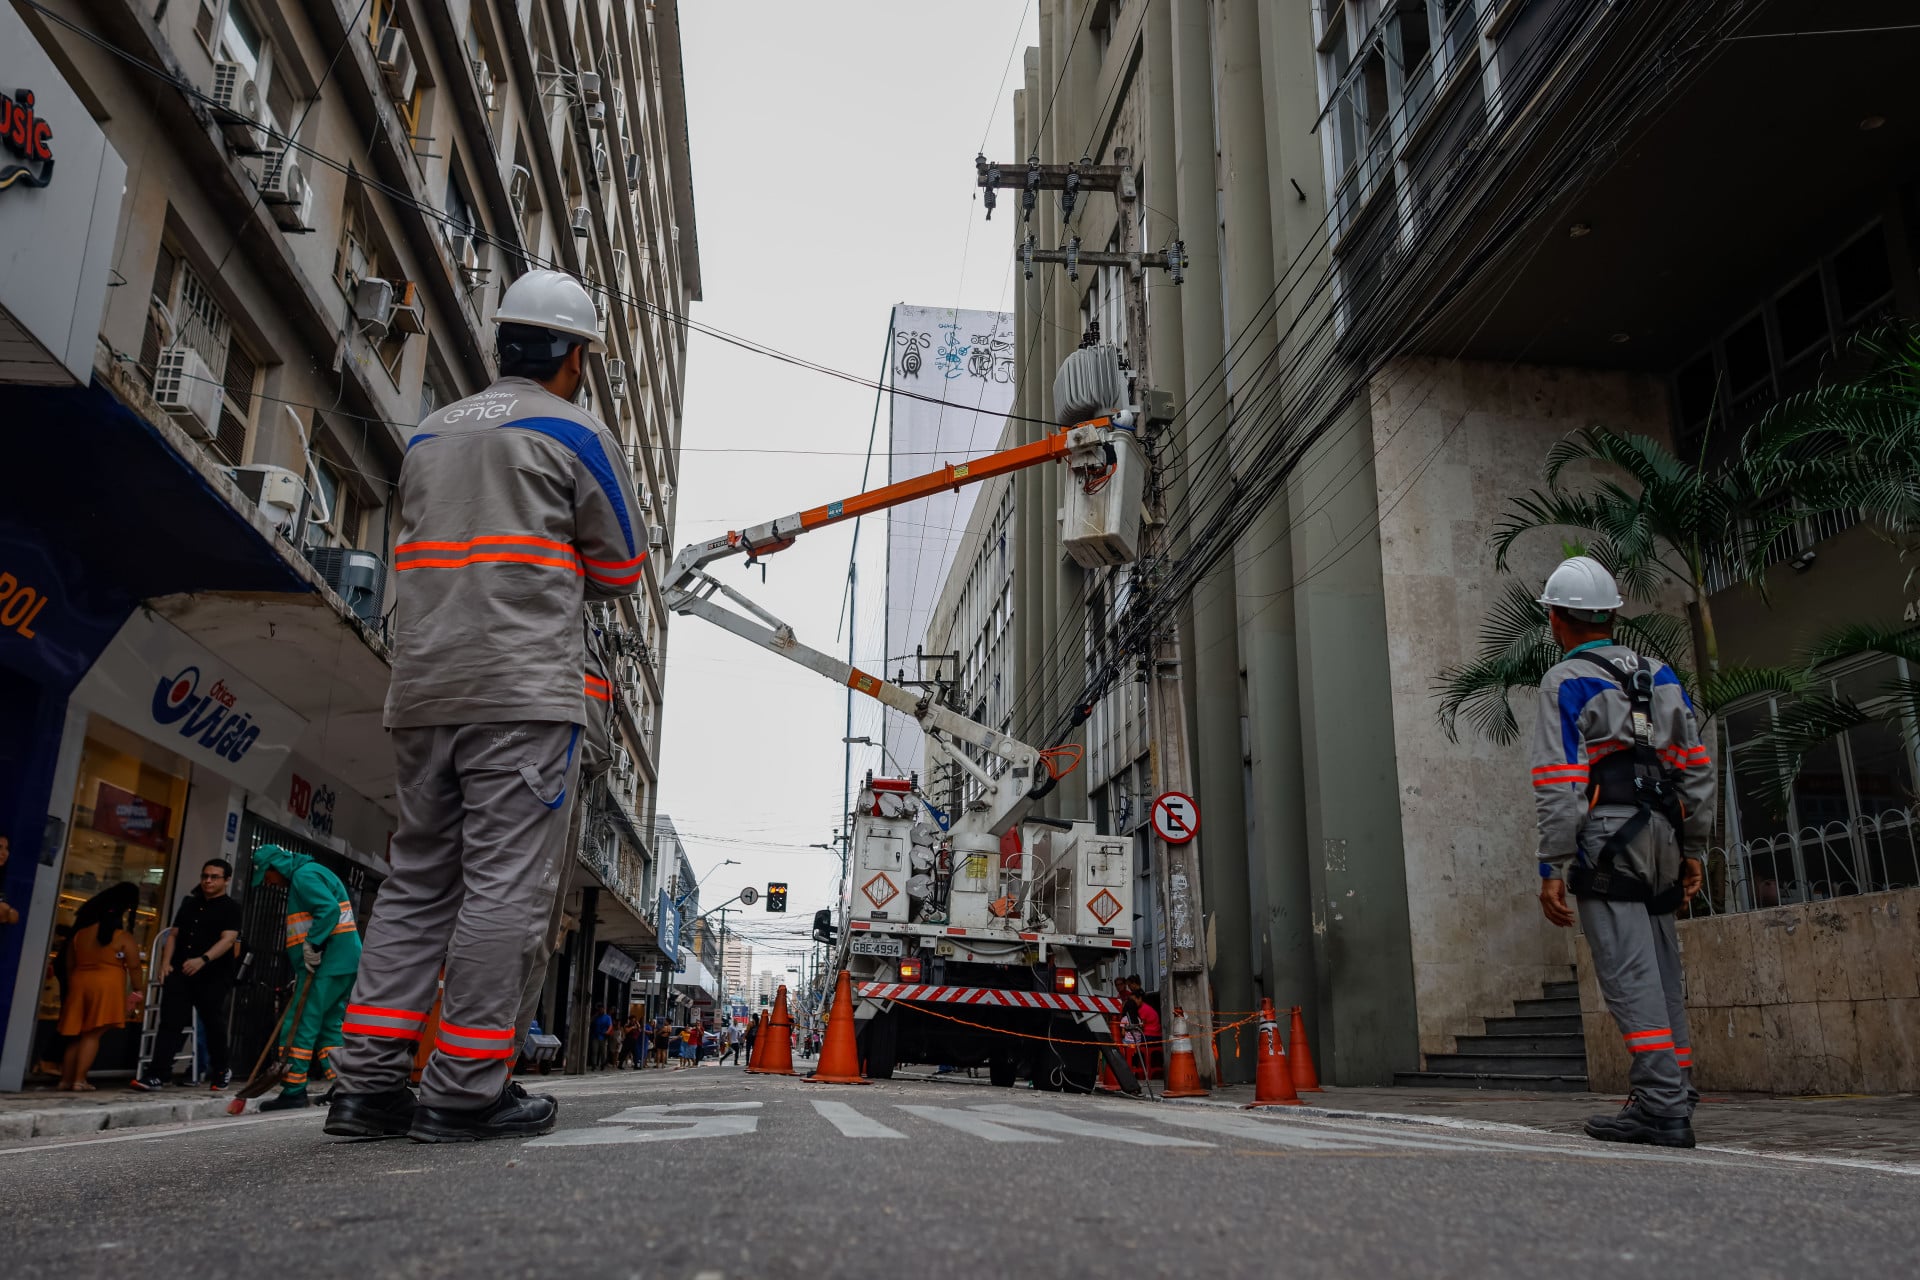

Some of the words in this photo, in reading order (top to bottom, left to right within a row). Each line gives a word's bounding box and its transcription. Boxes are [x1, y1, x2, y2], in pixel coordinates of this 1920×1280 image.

[443, 399, 519, 424] enel
[1903, 596, 1920, 621] 4
[209, 678, 237, 708] Óticas
[1166, 803, 1185, 831] E
[853, 943, 899, 954] GBE-4994
